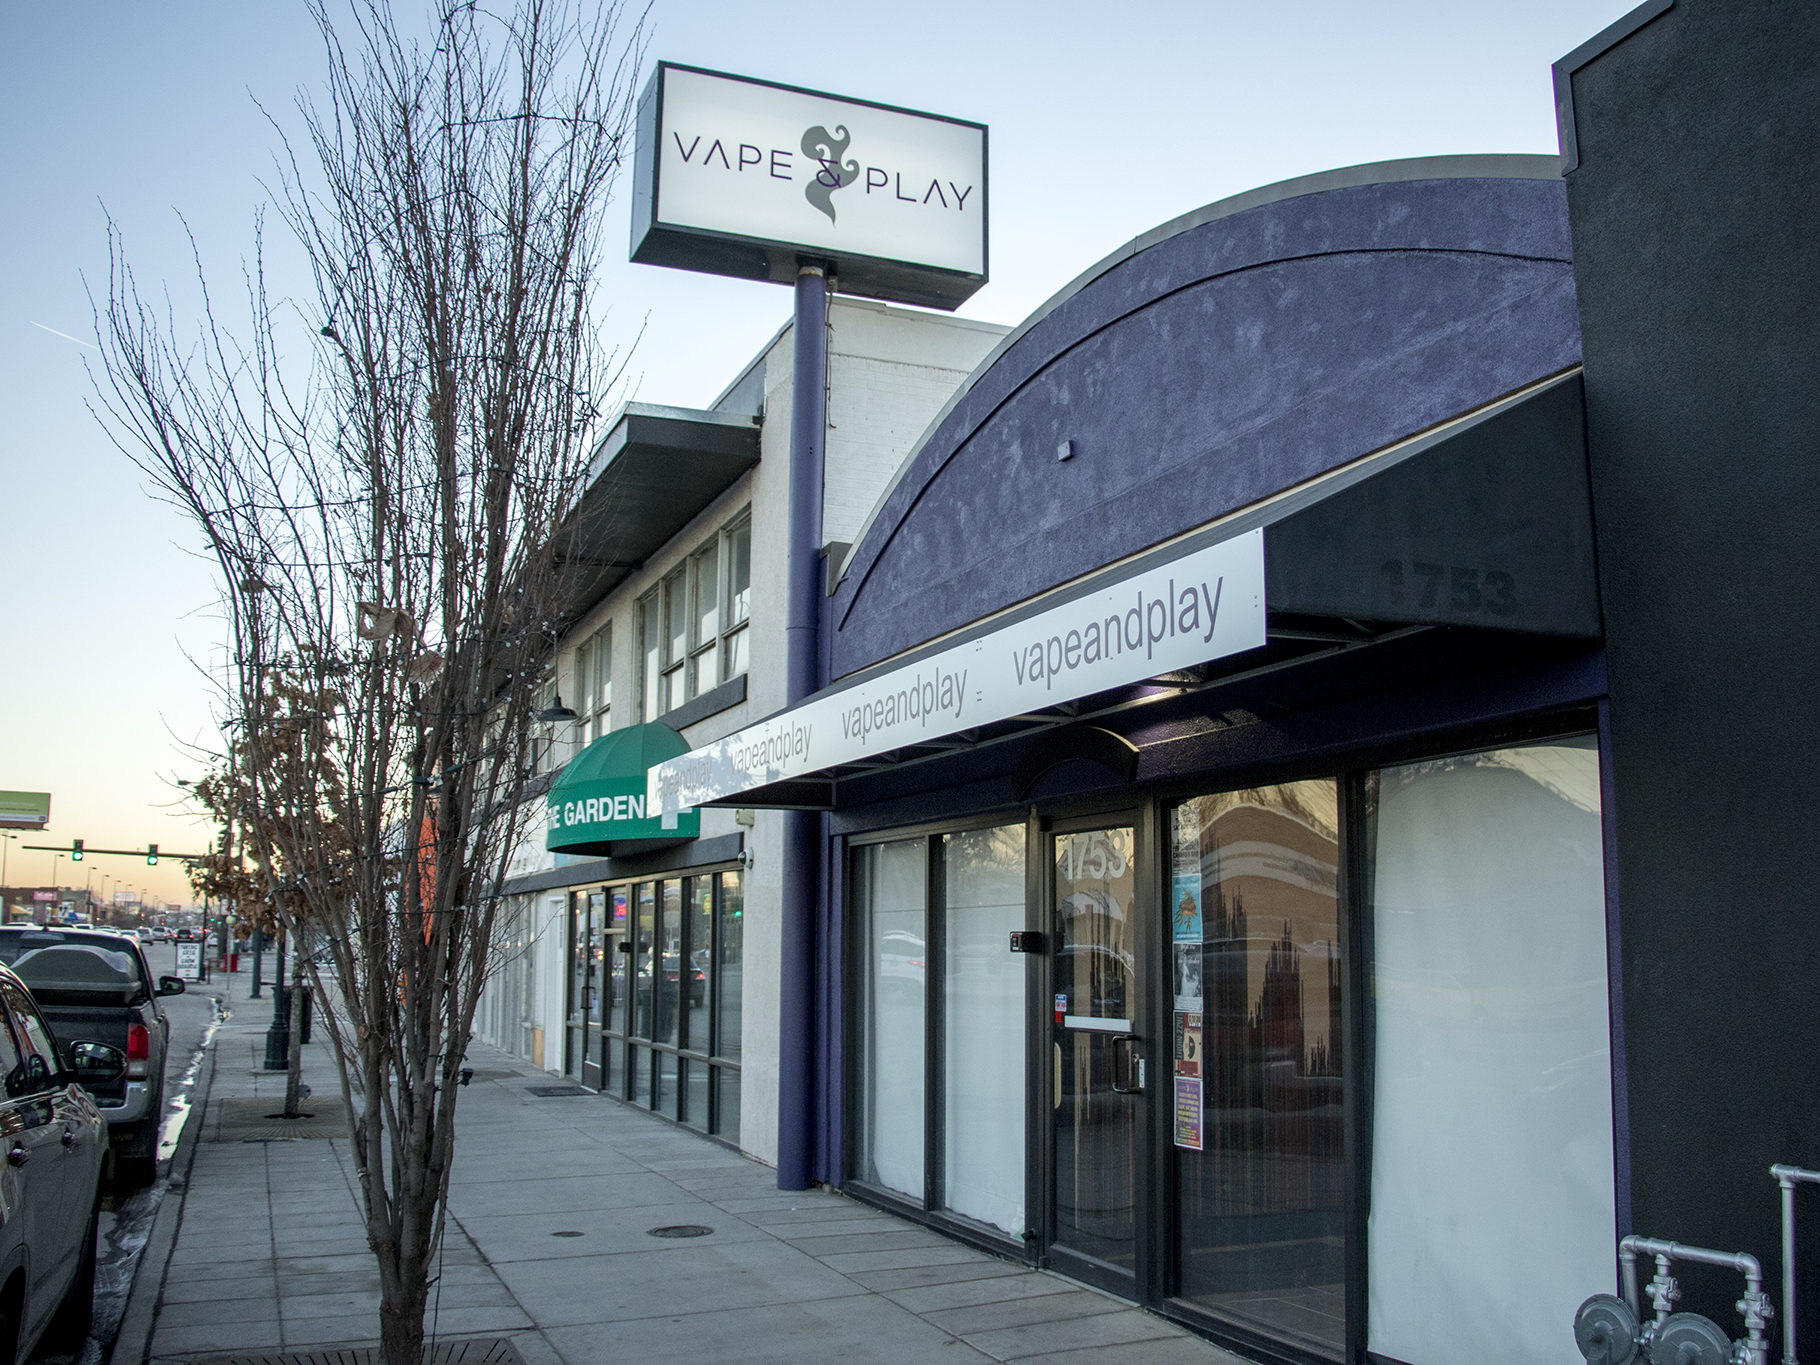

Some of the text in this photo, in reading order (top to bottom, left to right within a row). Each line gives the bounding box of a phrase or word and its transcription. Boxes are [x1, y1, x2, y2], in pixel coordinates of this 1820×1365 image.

[673, 131, 973, 211] VAPE & PLAY
[1381, 559, 1518, 616] 1753
[1013, 576, 1224, 691] vapeandplay
[842, 667, 967, 744] vapeandplay
[730, 721, 813, 780] vapeandplay
[564, 794, 645, 827] GARDEN
[1062, 830, 1126, 880] 1753
